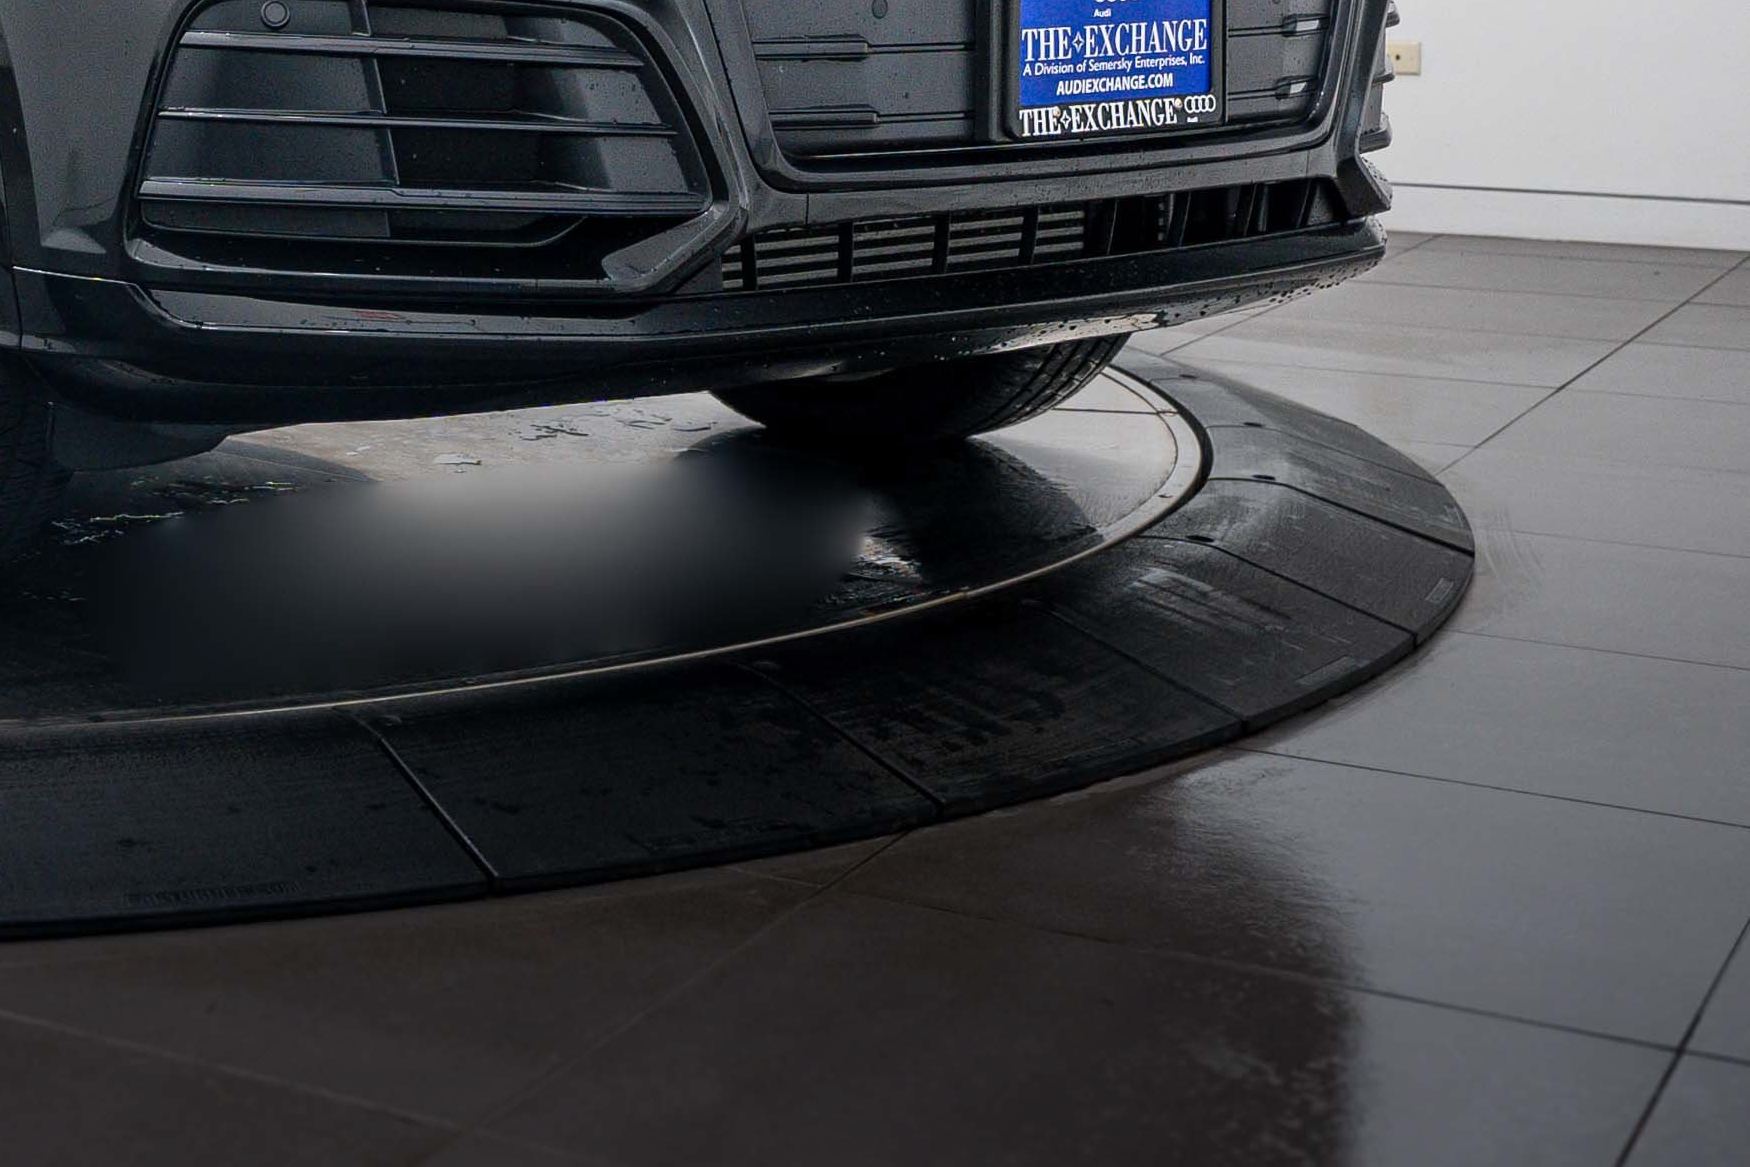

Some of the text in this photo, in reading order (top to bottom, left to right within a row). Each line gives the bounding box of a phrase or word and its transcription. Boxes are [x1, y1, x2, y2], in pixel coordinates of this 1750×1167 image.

[1093, 8, 1112, 18] Audi
[1021, 18, 1208, 61] THE EXCHANGE
[1022, 53, 1205, 76] A Division of Semersky Enterprises, Inc.
[1056, 73, 1174, 96] AUDIEXCHANGE.COM
[1019, 98, 1178, 137] THE EXCHANGE
